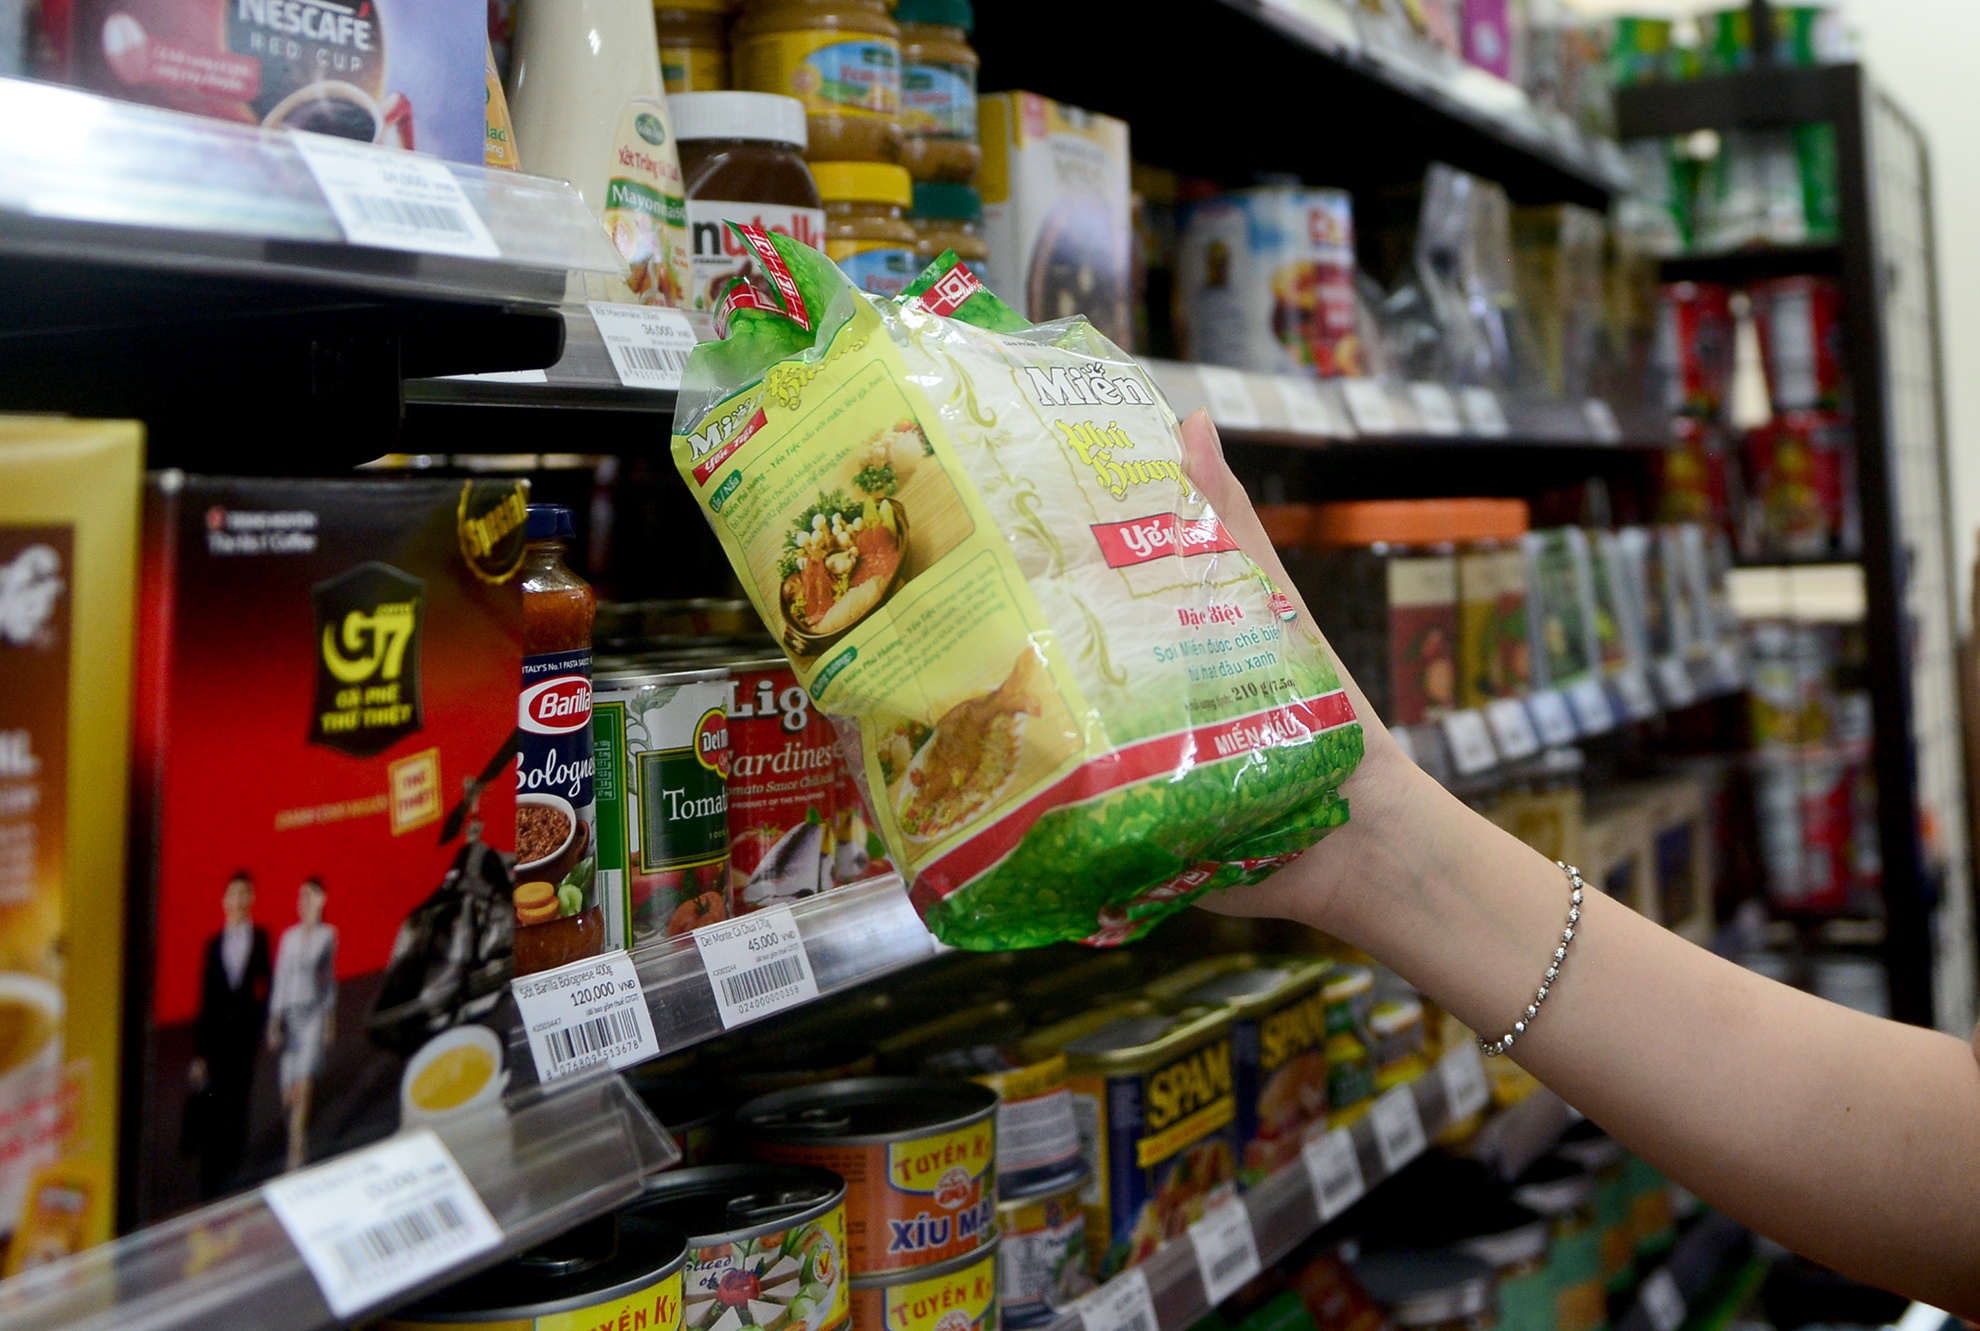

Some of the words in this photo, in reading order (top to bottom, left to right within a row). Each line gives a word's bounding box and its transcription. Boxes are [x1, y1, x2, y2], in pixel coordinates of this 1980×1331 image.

[251, 33, 302, 60] RED
[316, 47, 363, 72] CUP
[485, 120, 506, 142] lad
[612, 184, 687, 220] Mayonnaise
[1055, 420, 1135, 465] Phú
[724, 476, 739, 495] Nấu
[1177, 607, 1207, 630] Đặc
[323, 609, 416, 684] G7
[1207, 638, 1233, 656] được
[1235, 625, 1261, 648] chế
[522, 663, 548, 675] ITALY'S
[548, 661, 563, 672] No.1
[563, 660, 579, 669] PASTA
[1219, 659, 1243, 679] đậu
[1245, 650, 1277, 671] xanh
[537, 686, 591, 719] Barilla
[727, 680, 809, 732] Lig
[1231, 681, 1258, 701] 210
[702, 730, 720, 752] Del
[1213, 721, 1261, 756] MIẾN
[726, 783, 764, 797] omato
[766, 778, 799, 794] Sauce
[662, 785, 728, 821] Tomat
[700, 935, 713, 947] Del
[712, 929, 733, 945] Monte
[741, 922, 757, 936] Chua
[748, 931, 779, 952] 45,000
[558, 968, 596, 990] Bolognese
[570, 980, 615, 1008] 120,000
[559, 1054, 597, 1075] 076809
[602, 1039, 640, 1061] 513678
[1149, 1040, 1231, 1128] SPAM
[888, 1211, 950, 1253] XÍU
